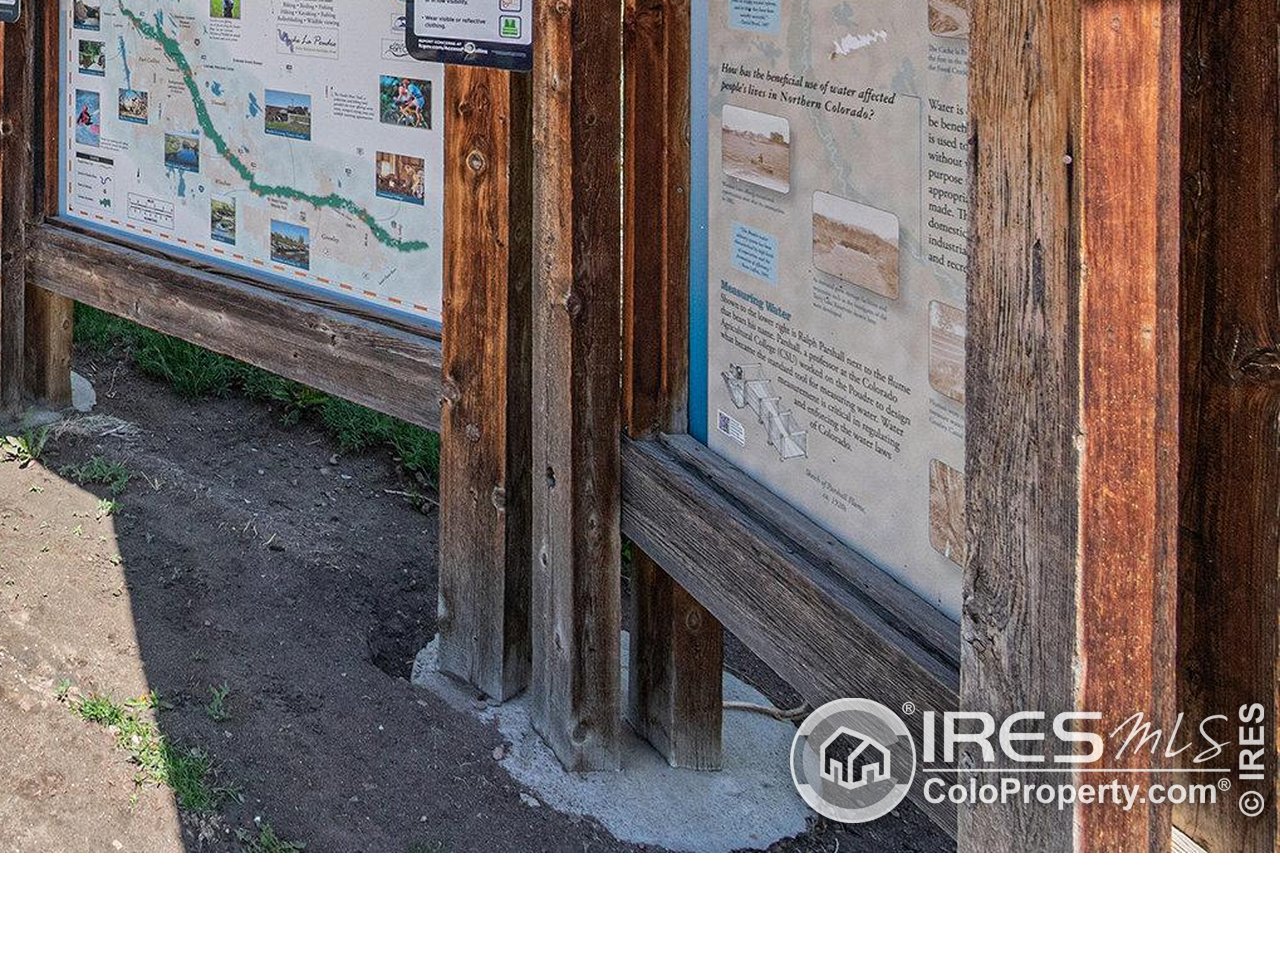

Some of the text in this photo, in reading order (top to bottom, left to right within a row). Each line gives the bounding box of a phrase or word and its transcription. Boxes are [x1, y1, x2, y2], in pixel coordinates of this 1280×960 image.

[721, 63, 897, 104] How has the beneficial use of water affected
[721, 81, 875, 120] people's lives in Northern Colorado?
[928, 98, 964, 115] Water is
[928, 115, 938, 128] be
[928, 133, 936, 144] is
[937, 135, 957, 148] used
[928, 151, 962, 167] without
[928, 168, 963, 186] purpose
[928, 201, 955, 217] made.
[928, 253, 944, 266] and
[721, 279, 764, 310] Measuring
[765, 300, 791, 321] Water
[747, 308, 757, 318] the
[873, 369, 887, 383] the
